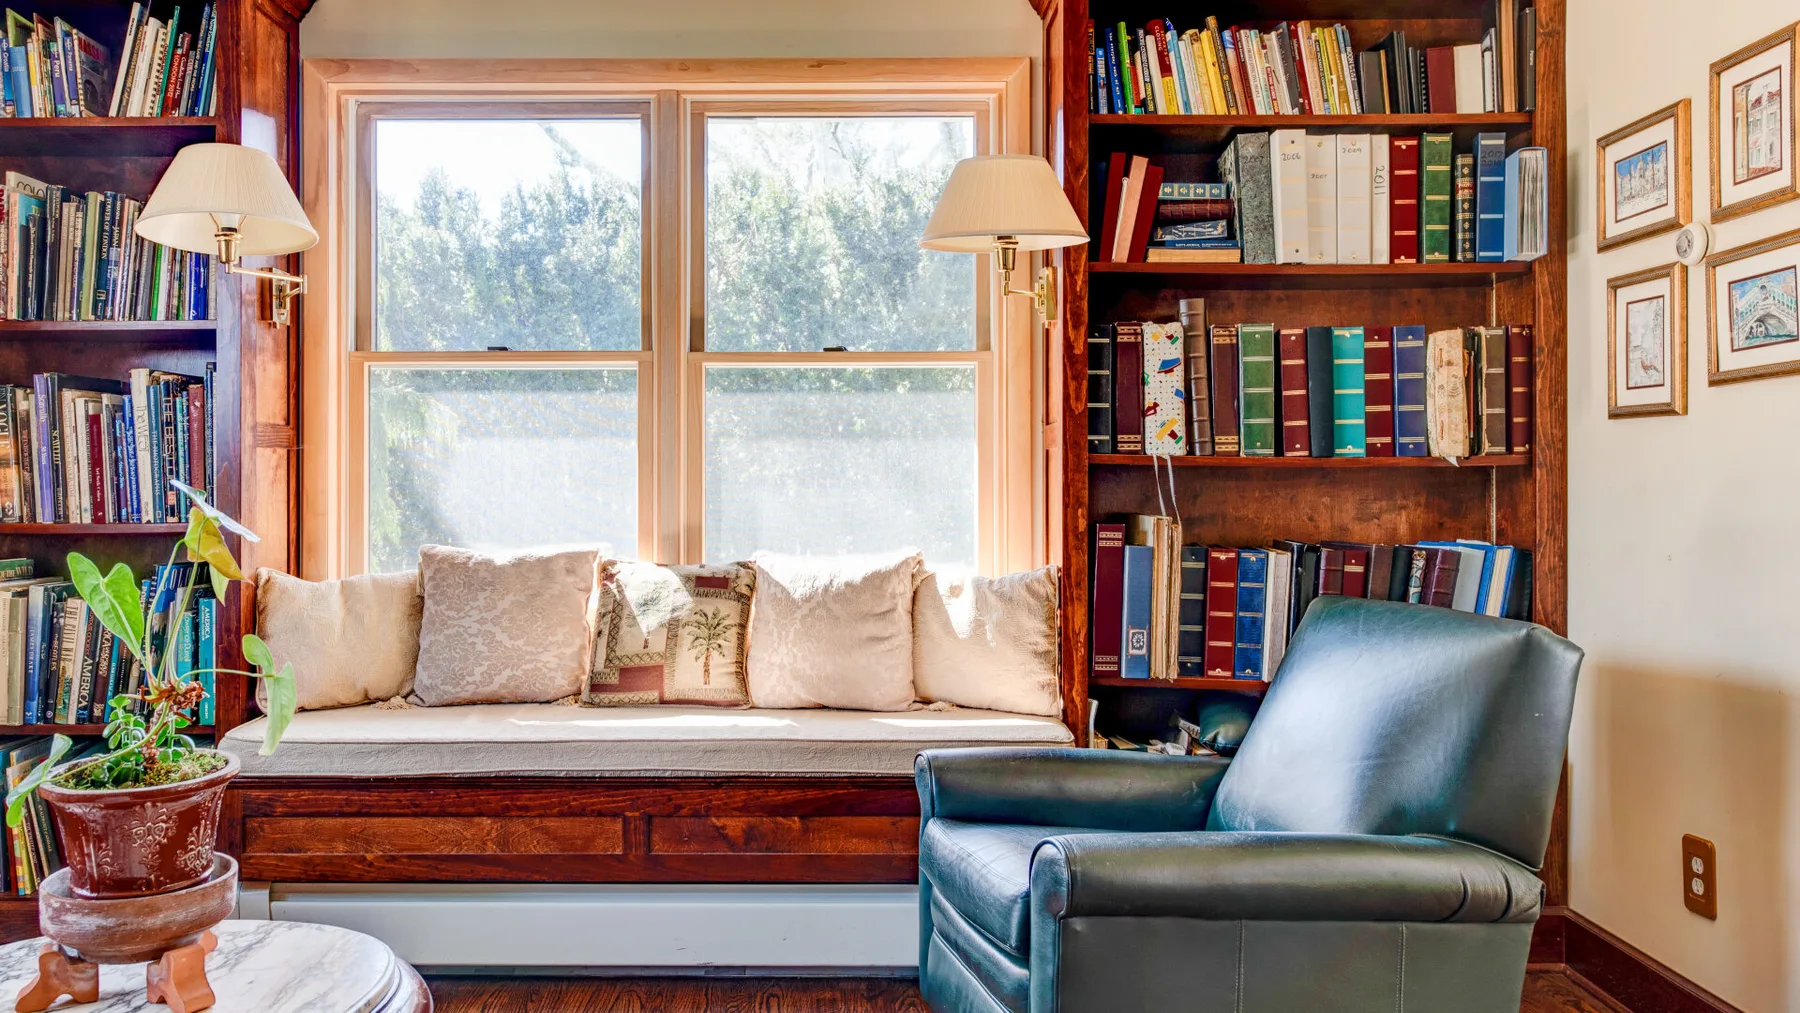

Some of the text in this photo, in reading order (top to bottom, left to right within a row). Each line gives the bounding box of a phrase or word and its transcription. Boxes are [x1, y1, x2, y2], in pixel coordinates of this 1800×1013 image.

[1154, 25, 1163, 52] CLOSING
[54, 60, 62, 78] Peru
[170, 55, 181, 84] LONDON
[168, 84, 176, 98] 2012
[1281, 152, 1302, 161] 2006
[1374, 165, 1386, 195] 2011
[104, 198, 112, 220] TOWER
[101, 233, 110, 260] LONDON
[111, 226, 120, 247] JAPAN
[164, 396, 174, 423] THE
[136, 406, 150, 454] The WEST
[164, 427, 174, 460] BEST
[52, 430, 60, 464] SCAVULLO
[65, 606, 79, 620] THE
[63, 624, 76, 644] CIVIL
[50, 640, 59, 671] BEATLES
[60, 647, 75, 662] WAR
[78, 656, 93, 708] AMERICA
